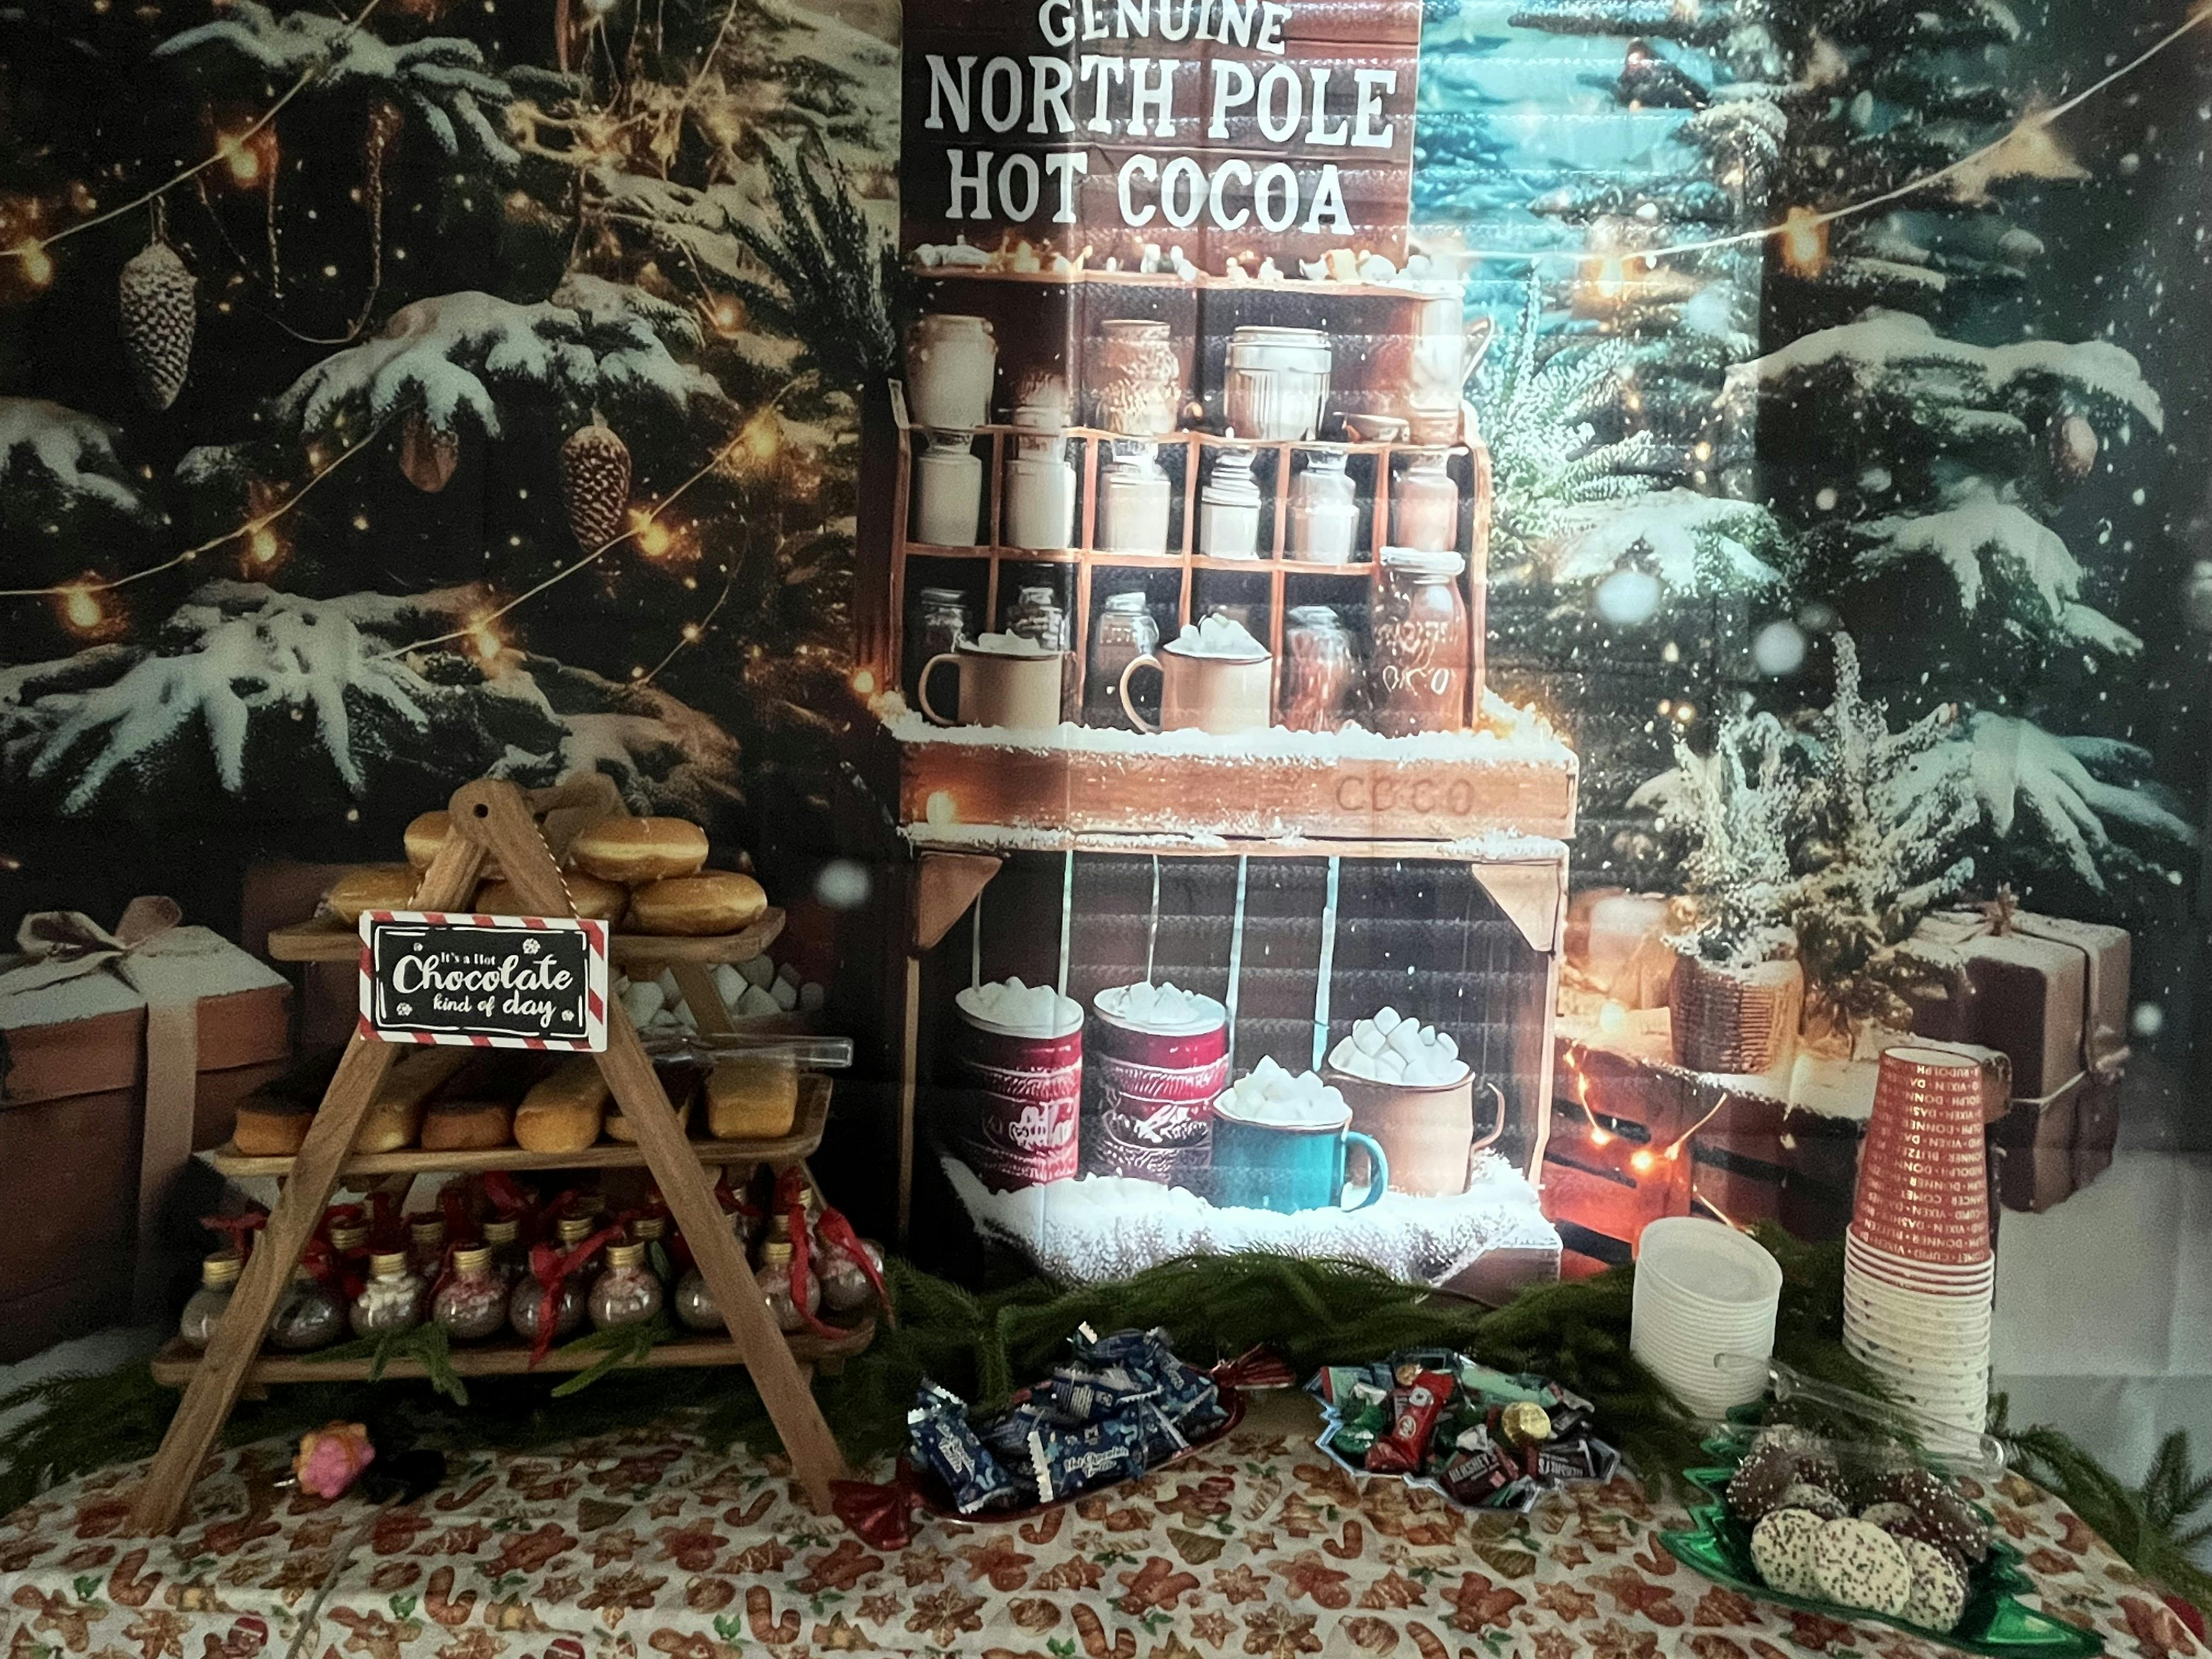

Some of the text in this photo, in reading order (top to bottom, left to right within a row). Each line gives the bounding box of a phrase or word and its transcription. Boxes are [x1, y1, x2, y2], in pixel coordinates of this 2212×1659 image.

[1039, 0, 1293, 54] GENUINE
[924, 54, 1397, 147] NORTH POLE
[946, 149, 1354, 235] HOT COCOA
[393, 953, 573, 994] Chocolate
[441, 951, 495, 965] It's a Hot
[433, 990, 557, 1028] kind of day
